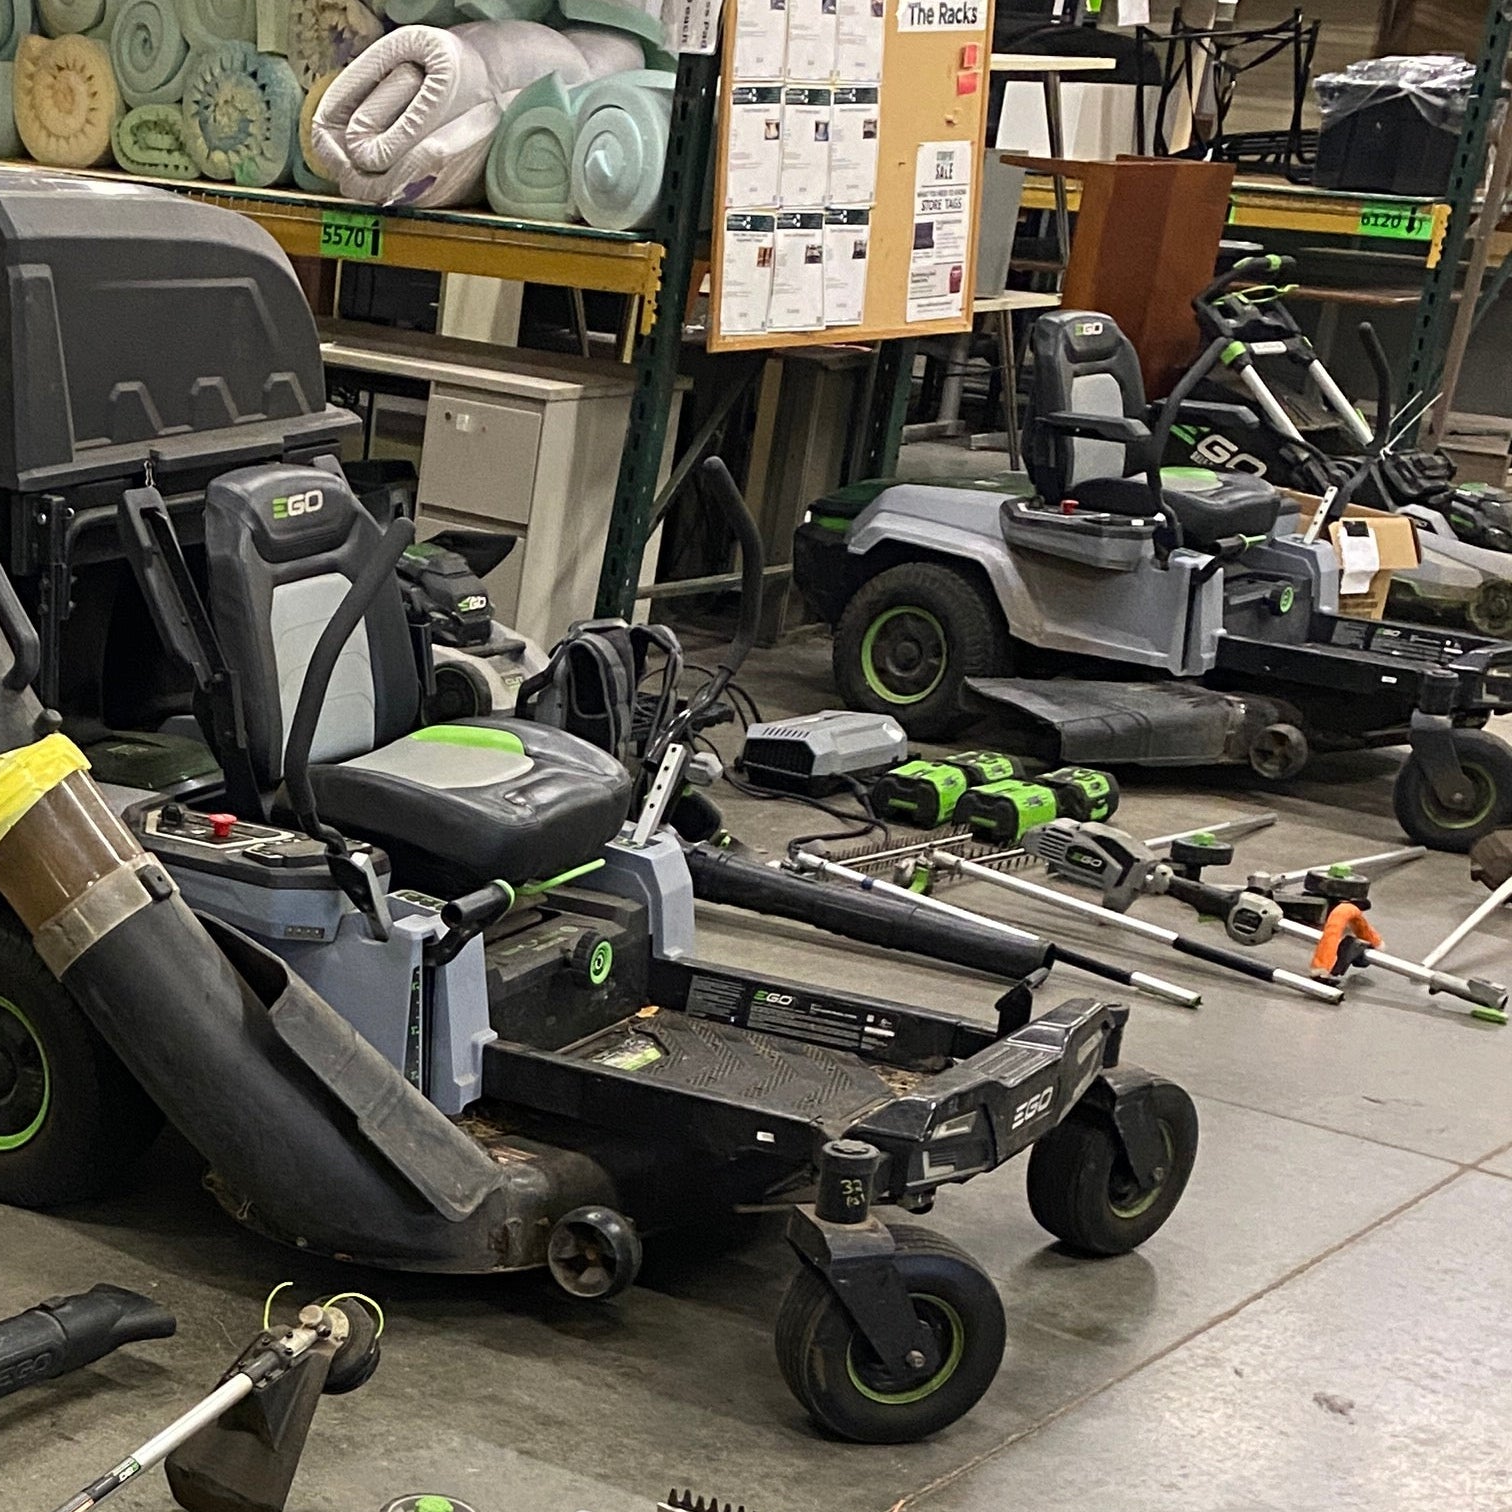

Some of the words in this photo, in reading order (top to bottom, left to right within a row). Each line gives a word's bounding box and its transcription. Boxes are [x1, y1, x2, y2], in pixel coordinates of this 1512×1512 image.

[908, 3, 935, 26] The
[938, 2, 978, 25] Racks
[321, 223, 366, 249] 5570
[1074, 321, 1104, 336] EGO
[272, 489, 324, 519] EGO
[753, 990, 794, 1006] EGO
[1011, 1085, 1055, 1131] EGO
[840, 1179, 863, 1195] 32
